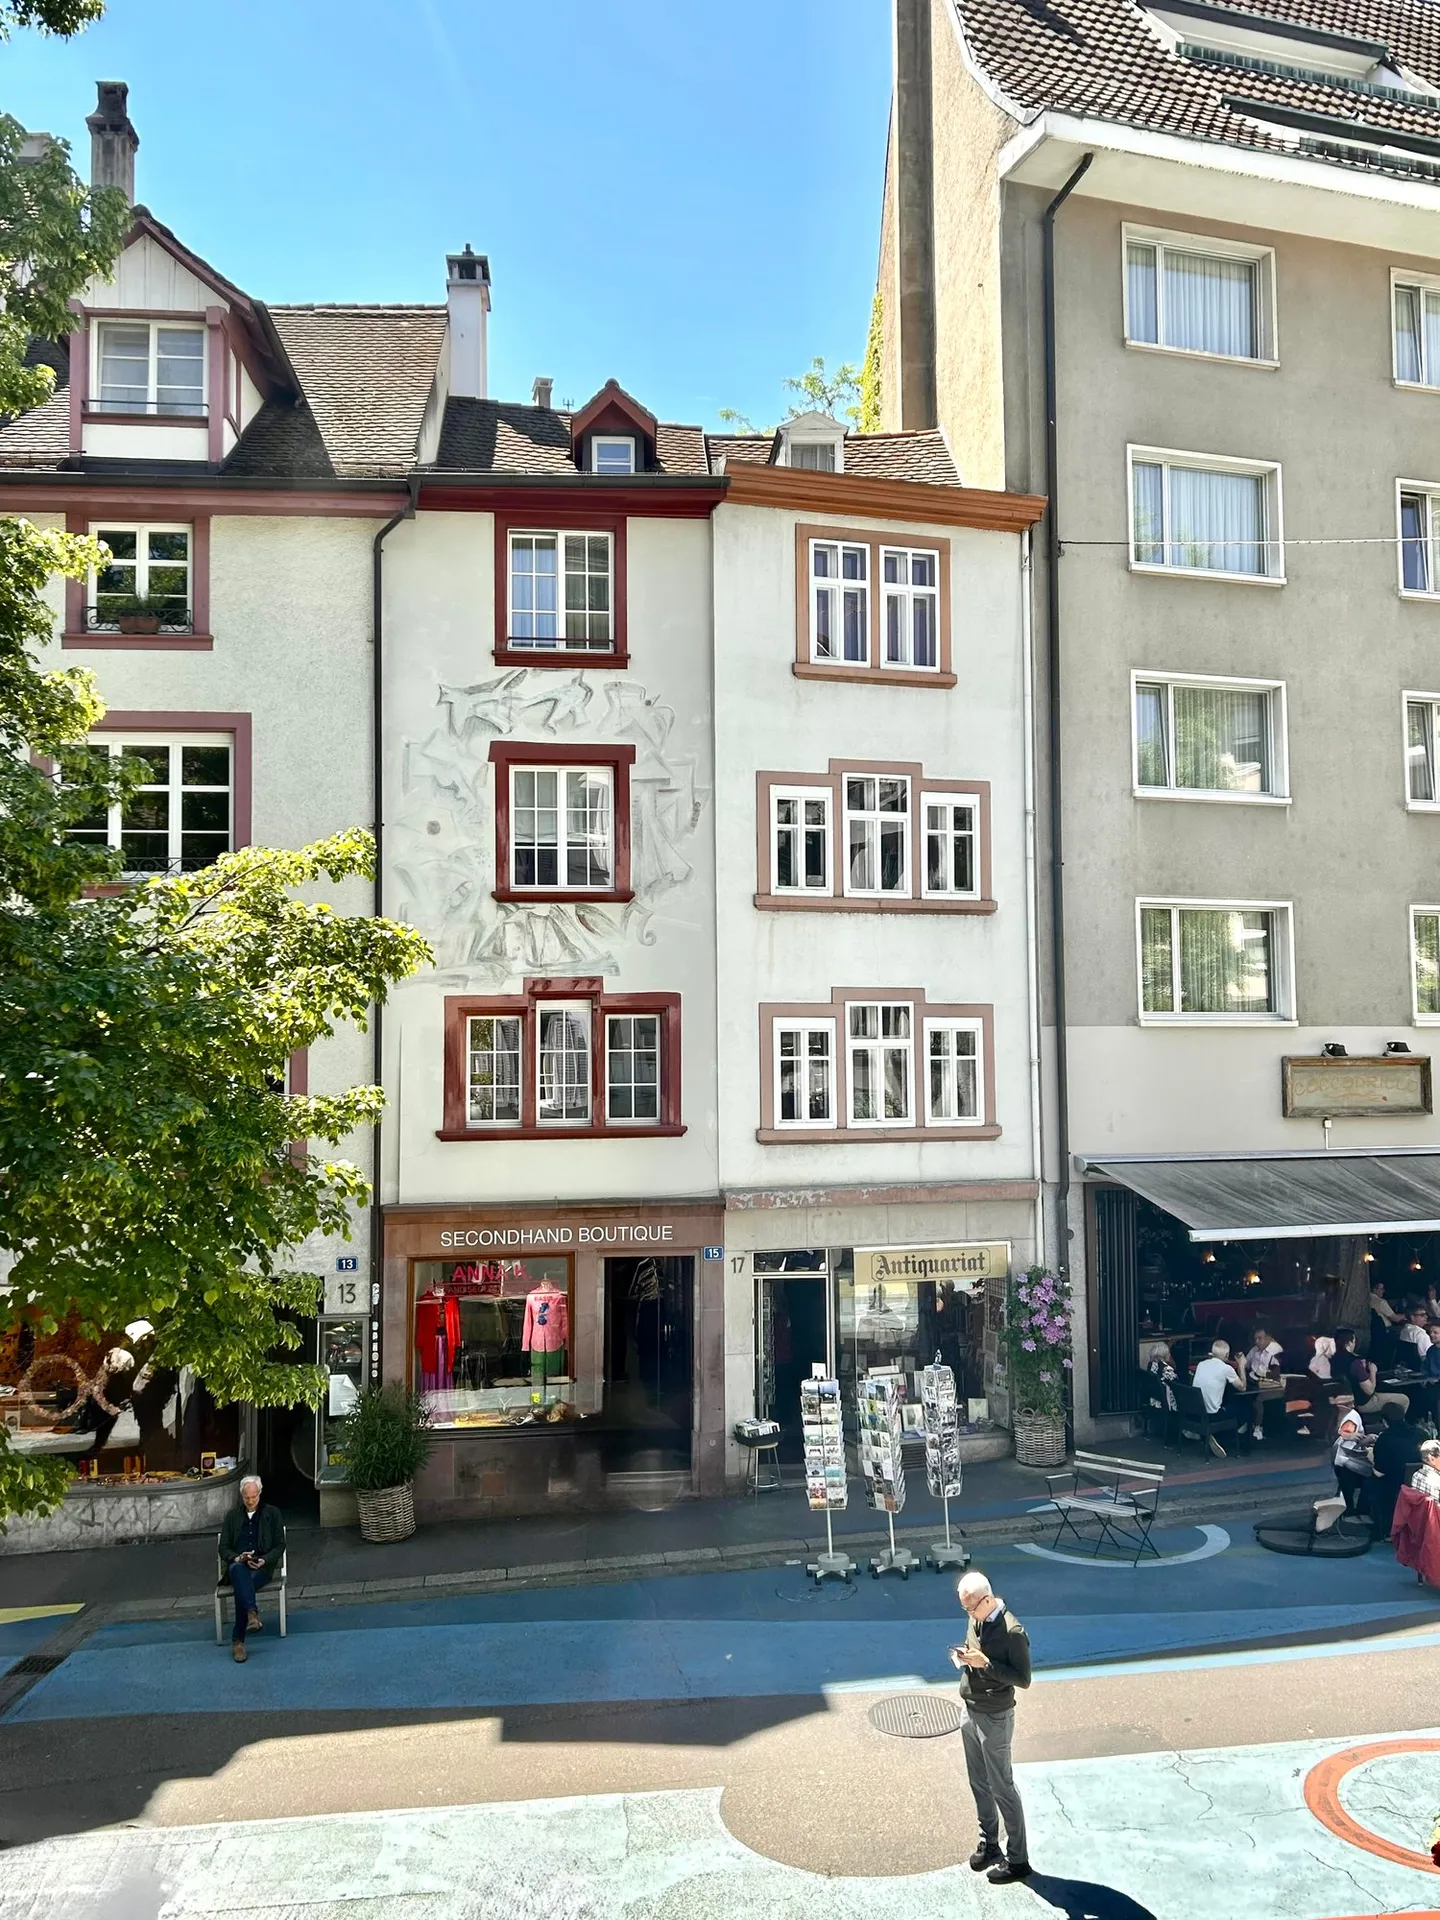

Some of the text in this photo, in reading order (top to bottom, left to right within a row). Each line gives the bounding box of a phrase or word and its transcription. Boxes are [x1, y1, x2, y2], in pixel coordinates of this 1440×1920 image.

[440, 1225, 673, 1247] SECONDHAND BOUTIQUE
[708, 1248, 720, 1258] 15
[341, 1259, 354, 1269] 13
[452, 1264, 508, 1282] ANNA
[730, 1256, 746, 1274] 17
[875, 1251, 986, 1280] Antiquariat
[337, 1283, 356, 1304] 13
